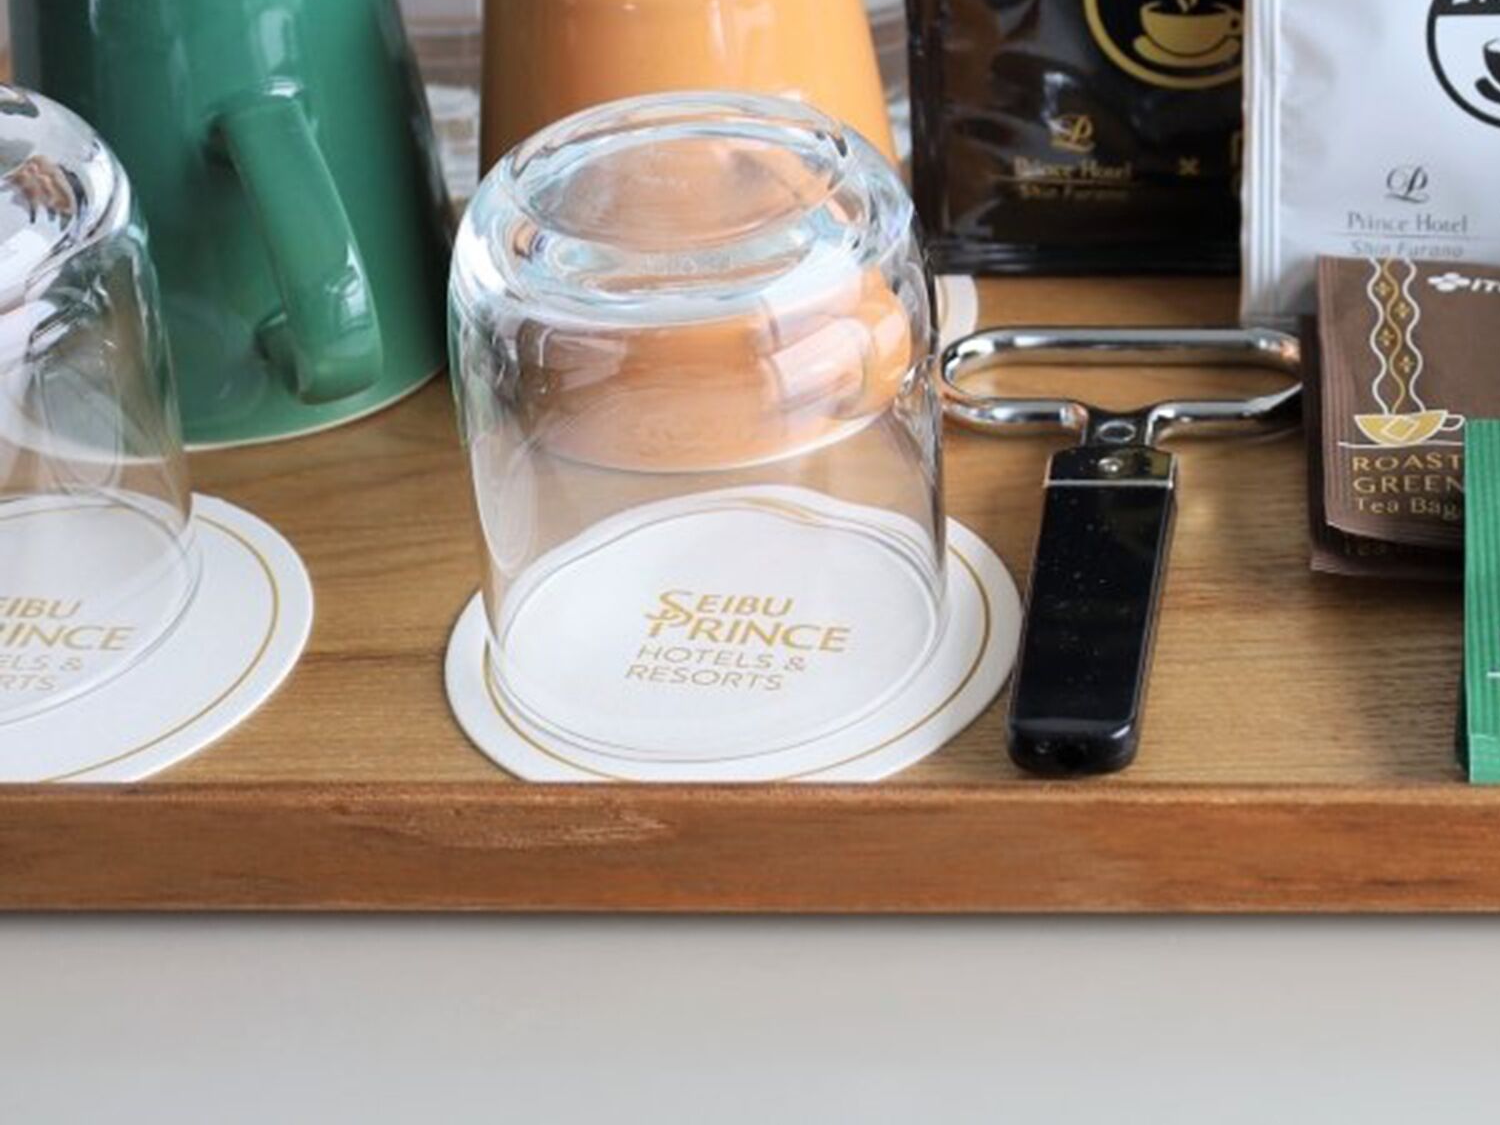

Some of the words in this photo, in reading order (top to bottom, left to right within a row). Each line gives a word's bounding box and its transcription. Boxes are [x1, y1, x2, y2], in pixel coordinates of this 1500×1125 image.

[1346, 211, 1408, 234] Prince
[1416, 211, 1468, 234] Hotel
[1351, 241, 1392, 258] Shin
[1396, 241, 1465, 259] Furano
[1352, 451, 1463, 473] ROAST
[1354, 496, 1400, 515] Tea
[1410, 495, 1458, 522] Bag
[650, 589, 796, 619] SEIBU
[0, 622, 138, 651] INCE
[645, 612, 853, 652] PRINCE
[636, 644, 774, 670] HOTELS
[783, 655, 808, 673] &
[624, 663, 785, 692] RESORTS
